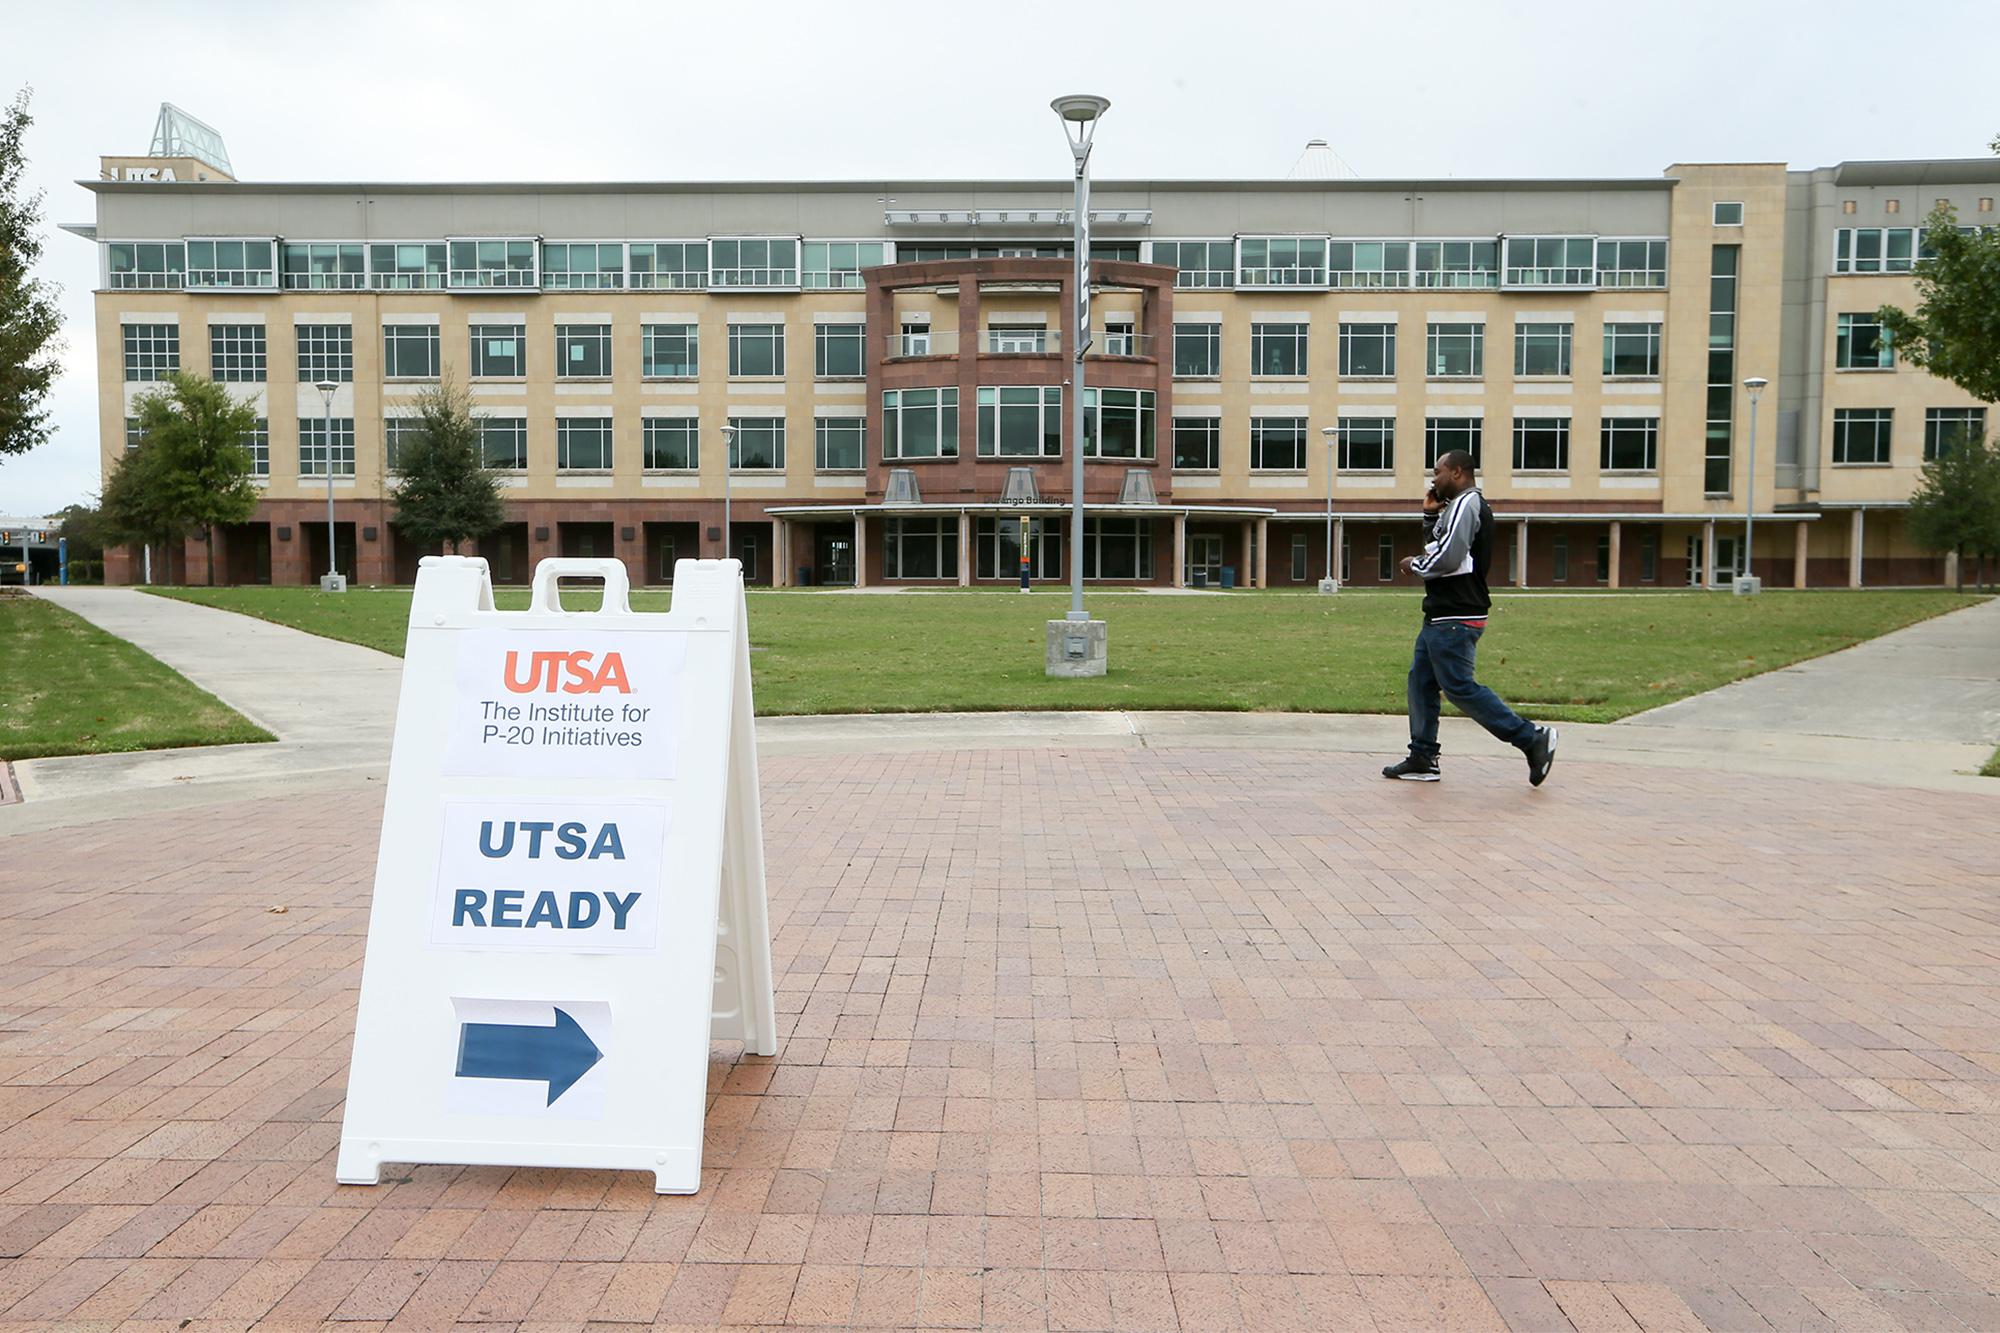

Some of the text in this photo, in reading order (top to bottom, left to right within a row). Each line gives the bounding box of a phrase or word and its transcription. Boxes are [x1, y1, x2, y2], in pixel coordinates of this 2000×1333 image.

[1026, 495, 1065, 506] Building
[503, 650, 632, 695] UTSA
[480, 701, 651, 723] The Institute for
[483, 725, 643, 747] P-20 Initiatives
[479, 821, 626, 860] UTSA
[452, 889, 642, 930] READY
